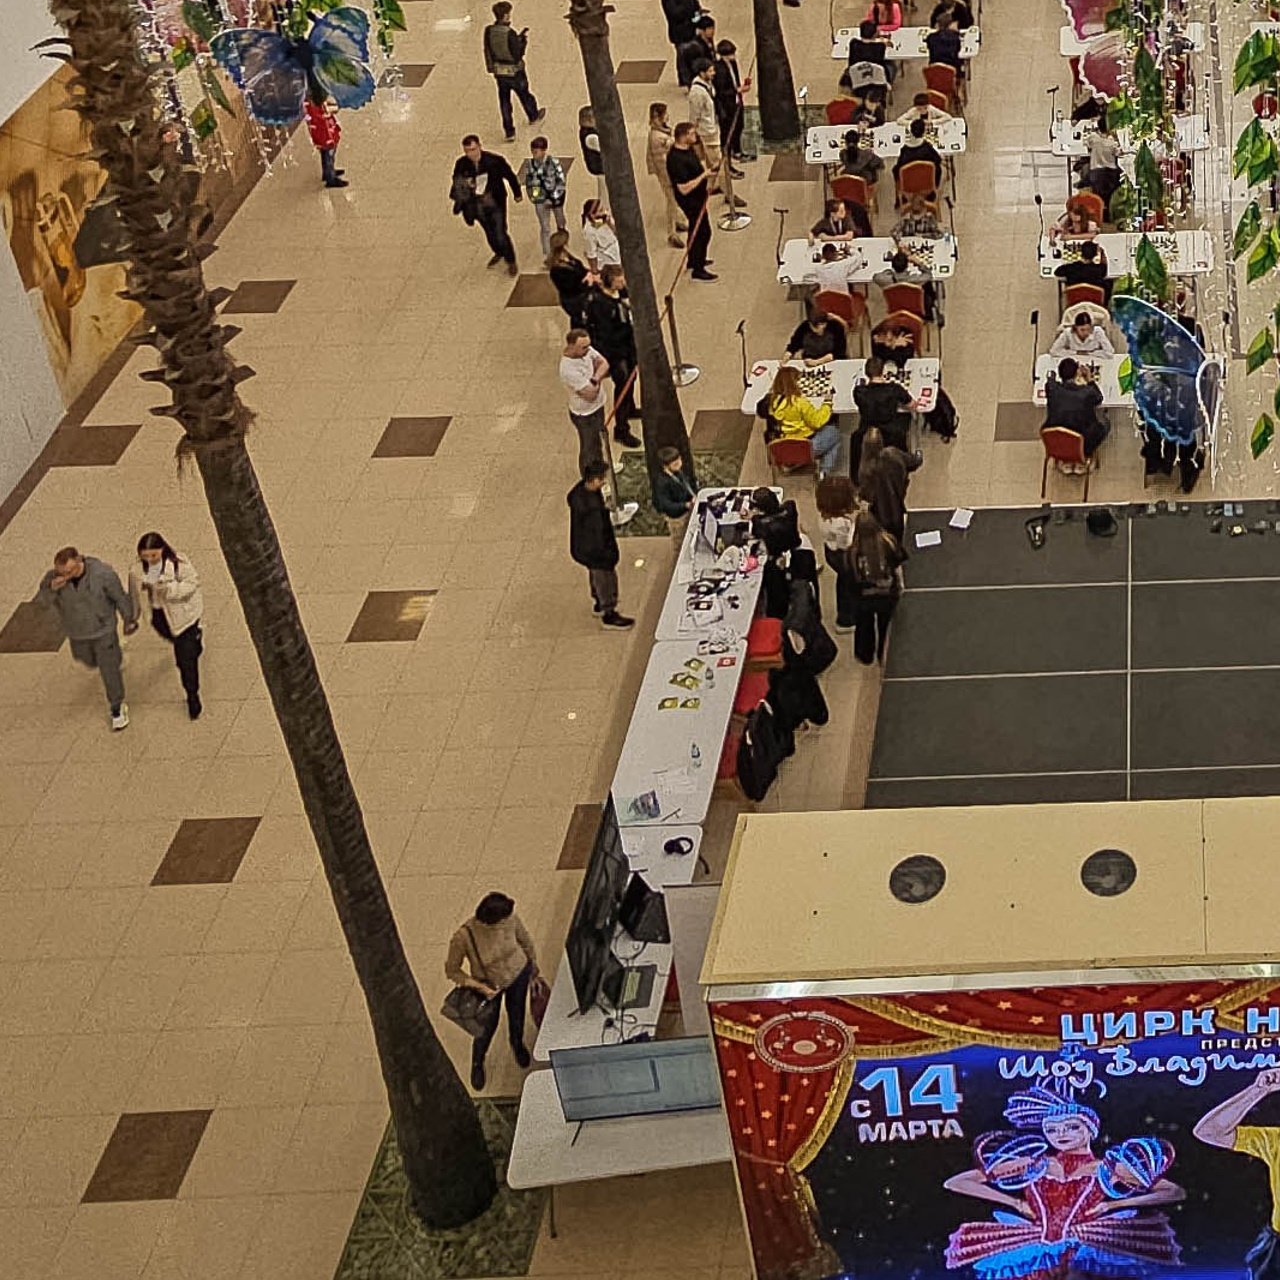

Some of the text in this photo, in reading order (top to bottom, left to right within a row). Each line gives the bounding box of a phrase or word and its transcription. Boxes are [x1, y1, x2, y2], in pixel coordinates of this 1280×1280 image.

[1061, 1009, 1216, 1045] ЦИРК
[999, 1055, 1093, 1088] Шоу
[859, 1063, 963, 1117] 14
[858, 1118, 964, 1143] МАРТА
